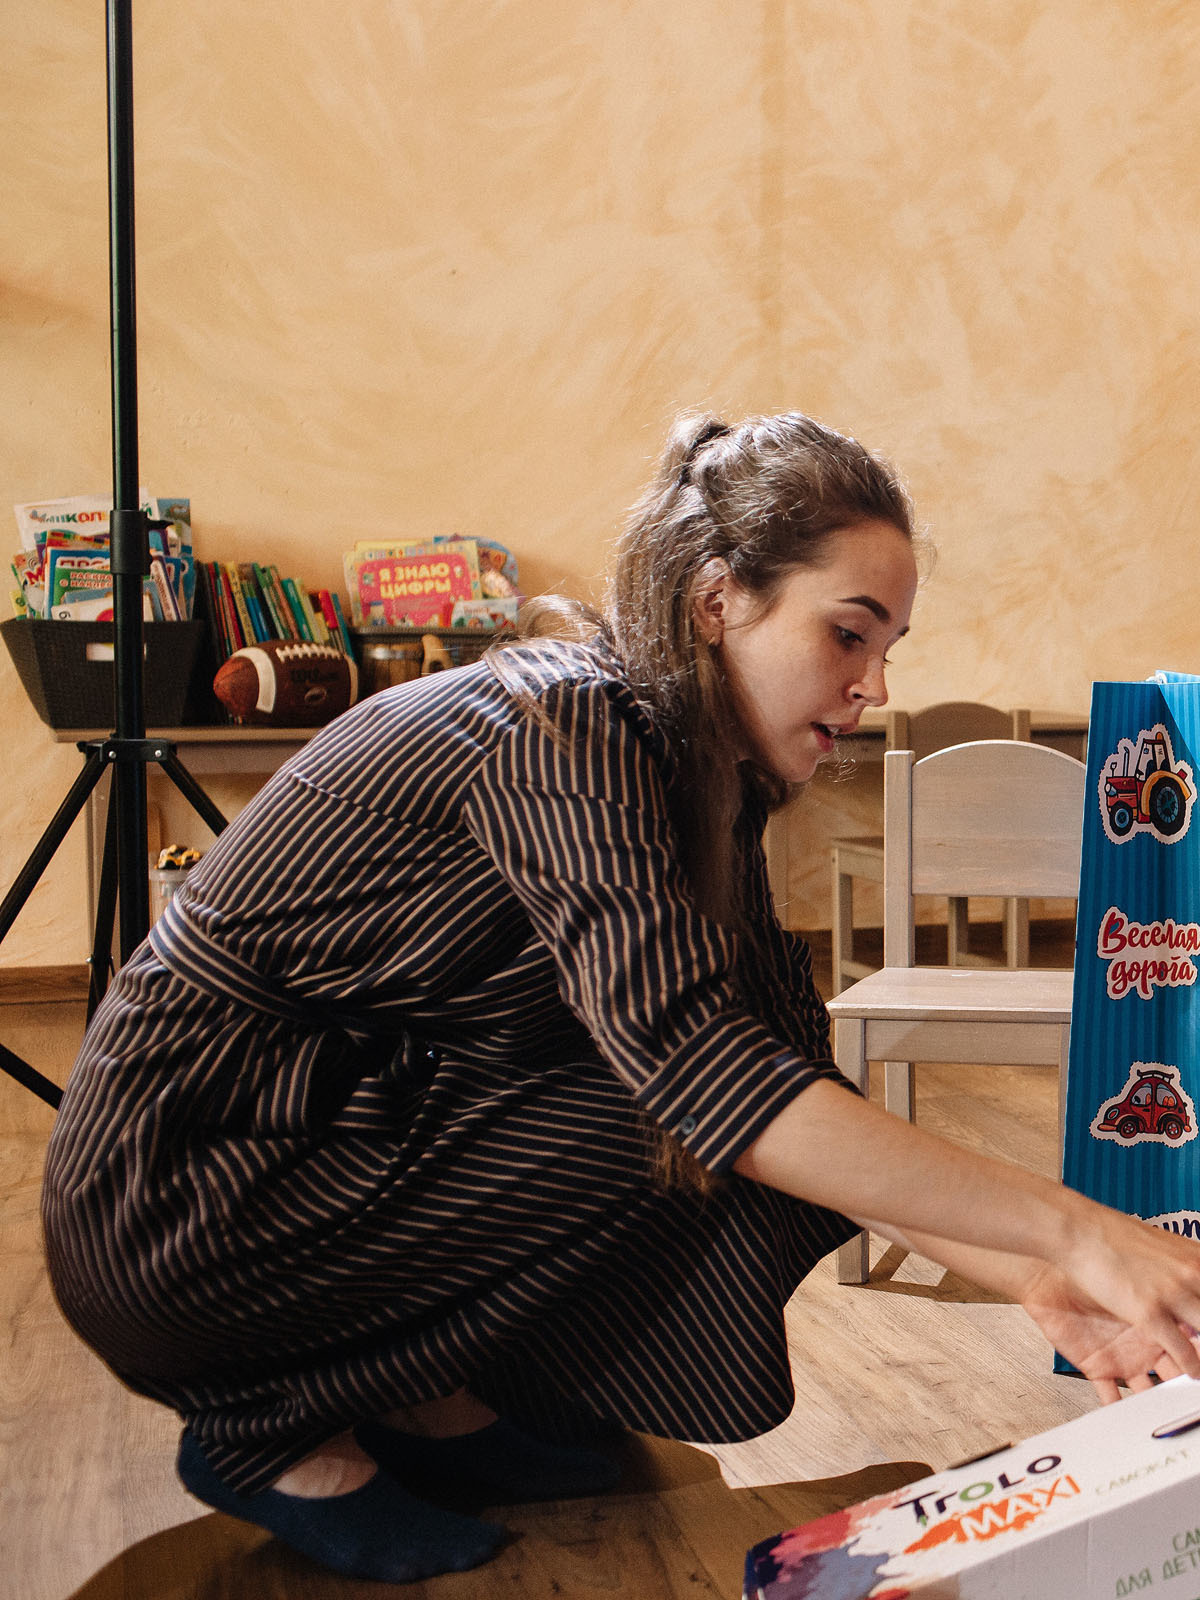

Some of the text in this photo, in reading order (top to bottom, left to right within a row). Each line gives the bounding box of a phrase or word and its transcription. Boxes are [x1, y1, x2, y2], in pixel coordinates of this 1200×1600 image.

[70, 571, 112, 582] РАСКРА
[379, 562, 450, 582] Я ЗНАЮ
[380, 578, 451, 599] ЦИФРЫ
[1111, 956, 1195, 994] дорога
[1095, 1448, 1190, 1496] САМОКАТ
[960, 1474, 1081, 1542] MAXI
[1115, 1567, 1153, 1598] ДЛЯ
